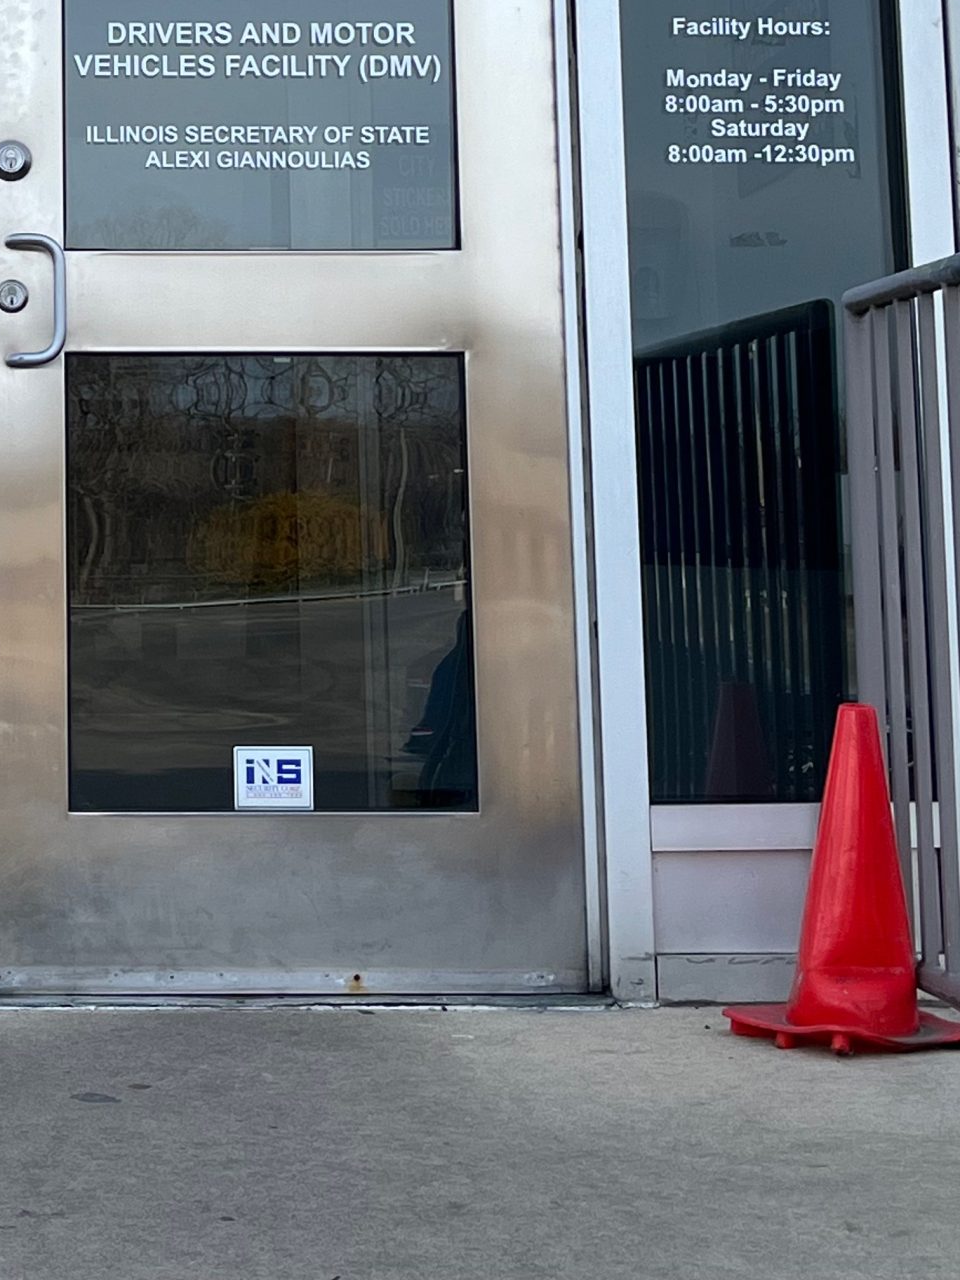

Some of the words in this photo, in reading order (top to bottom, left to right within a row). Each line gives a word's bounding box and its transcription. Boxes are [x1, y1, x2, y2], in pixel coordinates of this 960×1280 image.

[107, 22, 233, 45] DRIVERS
[240, 22, 301, 45] AND
[310, 22, 417, 45] MOTOR
[672, 17, 751, 40] Facility
[757, 17, 831, 37] Hours:
[73, 54, 216, 78] VEHICLES
[225, 54, 352, 78] FACILITY
[359, 54, 442, 84] (DMV)
[666, 68, 753, 92] Monday
[773, 68, 842, 92] Friday
[665, 94, 744, 114] 8:00am
[764, 94, 845, 117] 5:30pm
[86, 125, 178, 144] ILLINOIS
[185, 125, 319, 144] SECRETARY
[324, 125, 354, 144] OF
[360, 125, 430, 144] STATE
[711, 118, 810, 141] Saturday
[145, 150, 210, 169] ALEXI
[216, 150, 370, 170] GIANNOULIAS
[668, 144, 747, 164] 8:00am
